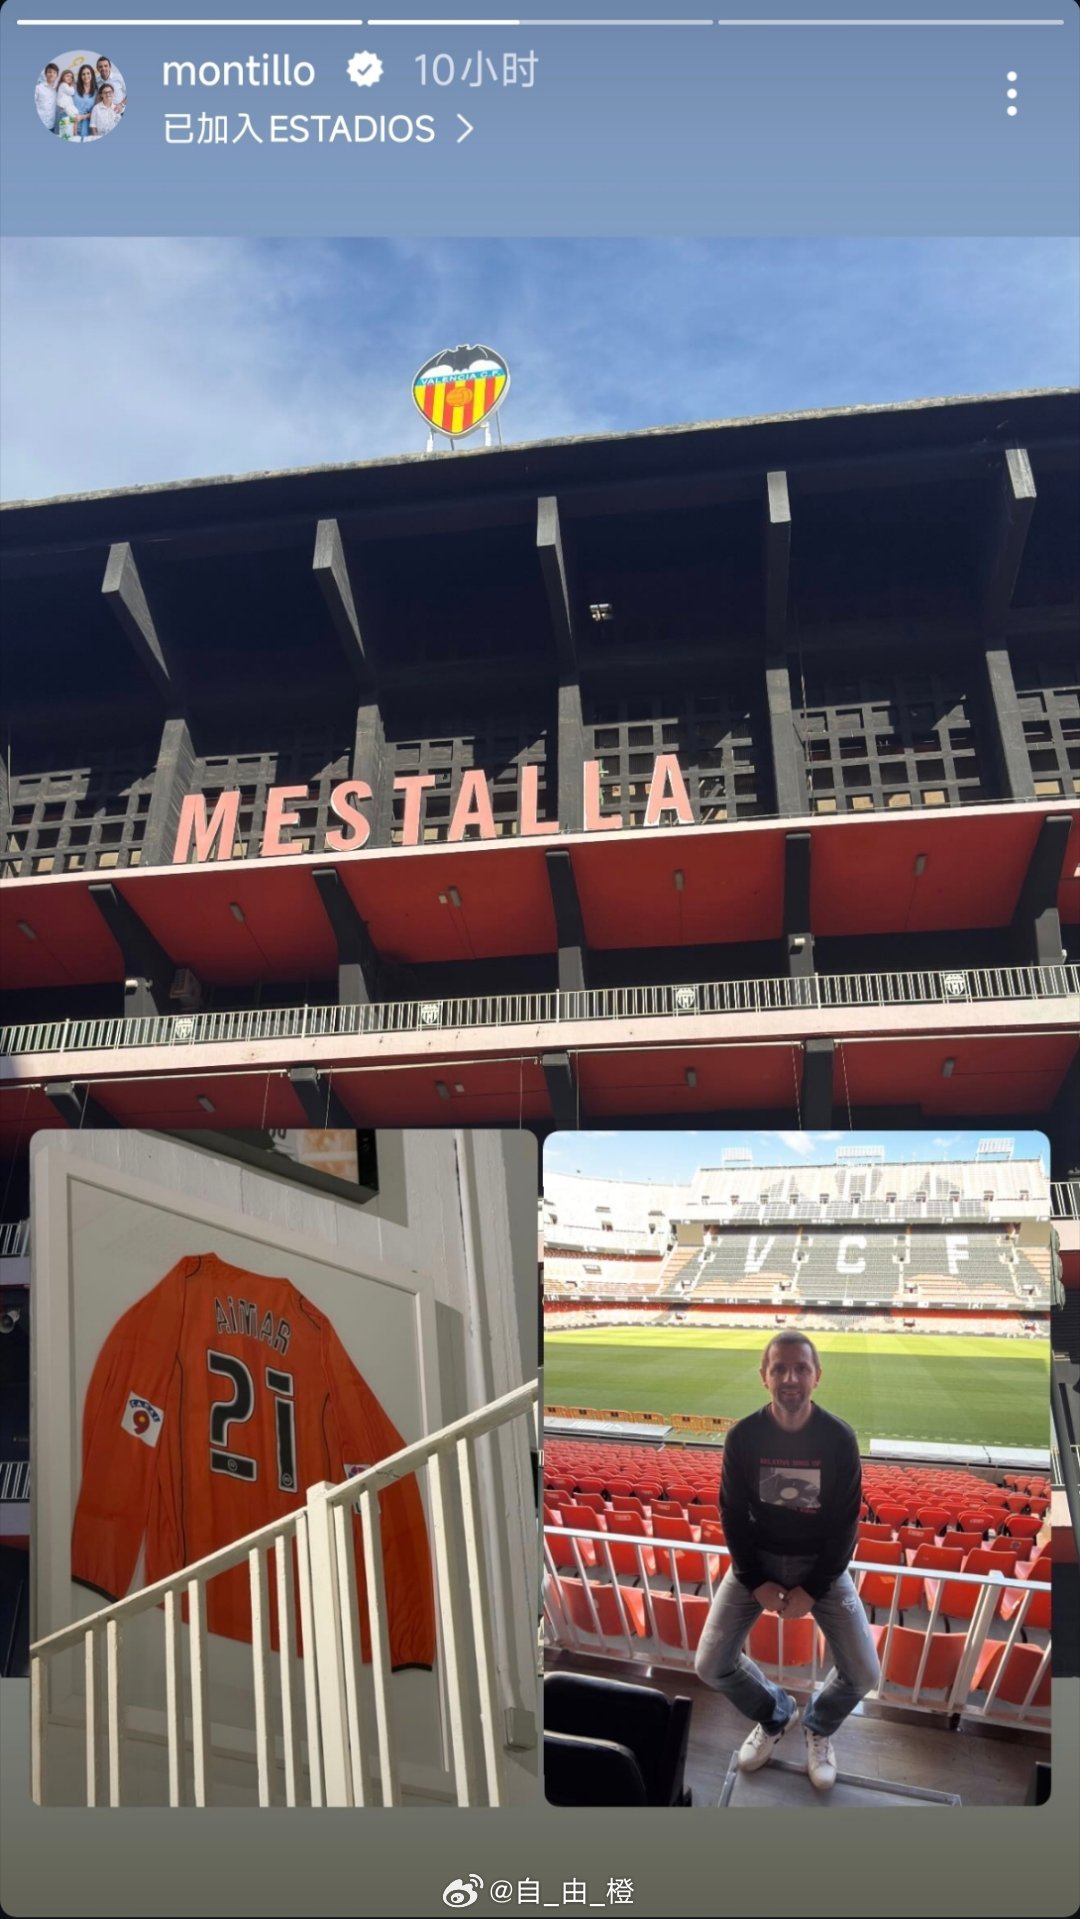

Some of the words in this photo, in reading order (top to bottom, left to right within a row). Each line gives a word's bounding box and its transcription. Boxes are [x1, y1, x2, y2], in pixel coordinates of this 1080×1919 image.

[421, 373, 477, 385] VALENCIA
[172, 754, 695, 864] MESTALLA
[133, 1409, 151, 1435] 9
[207, 1348, 298, 1493] 21
